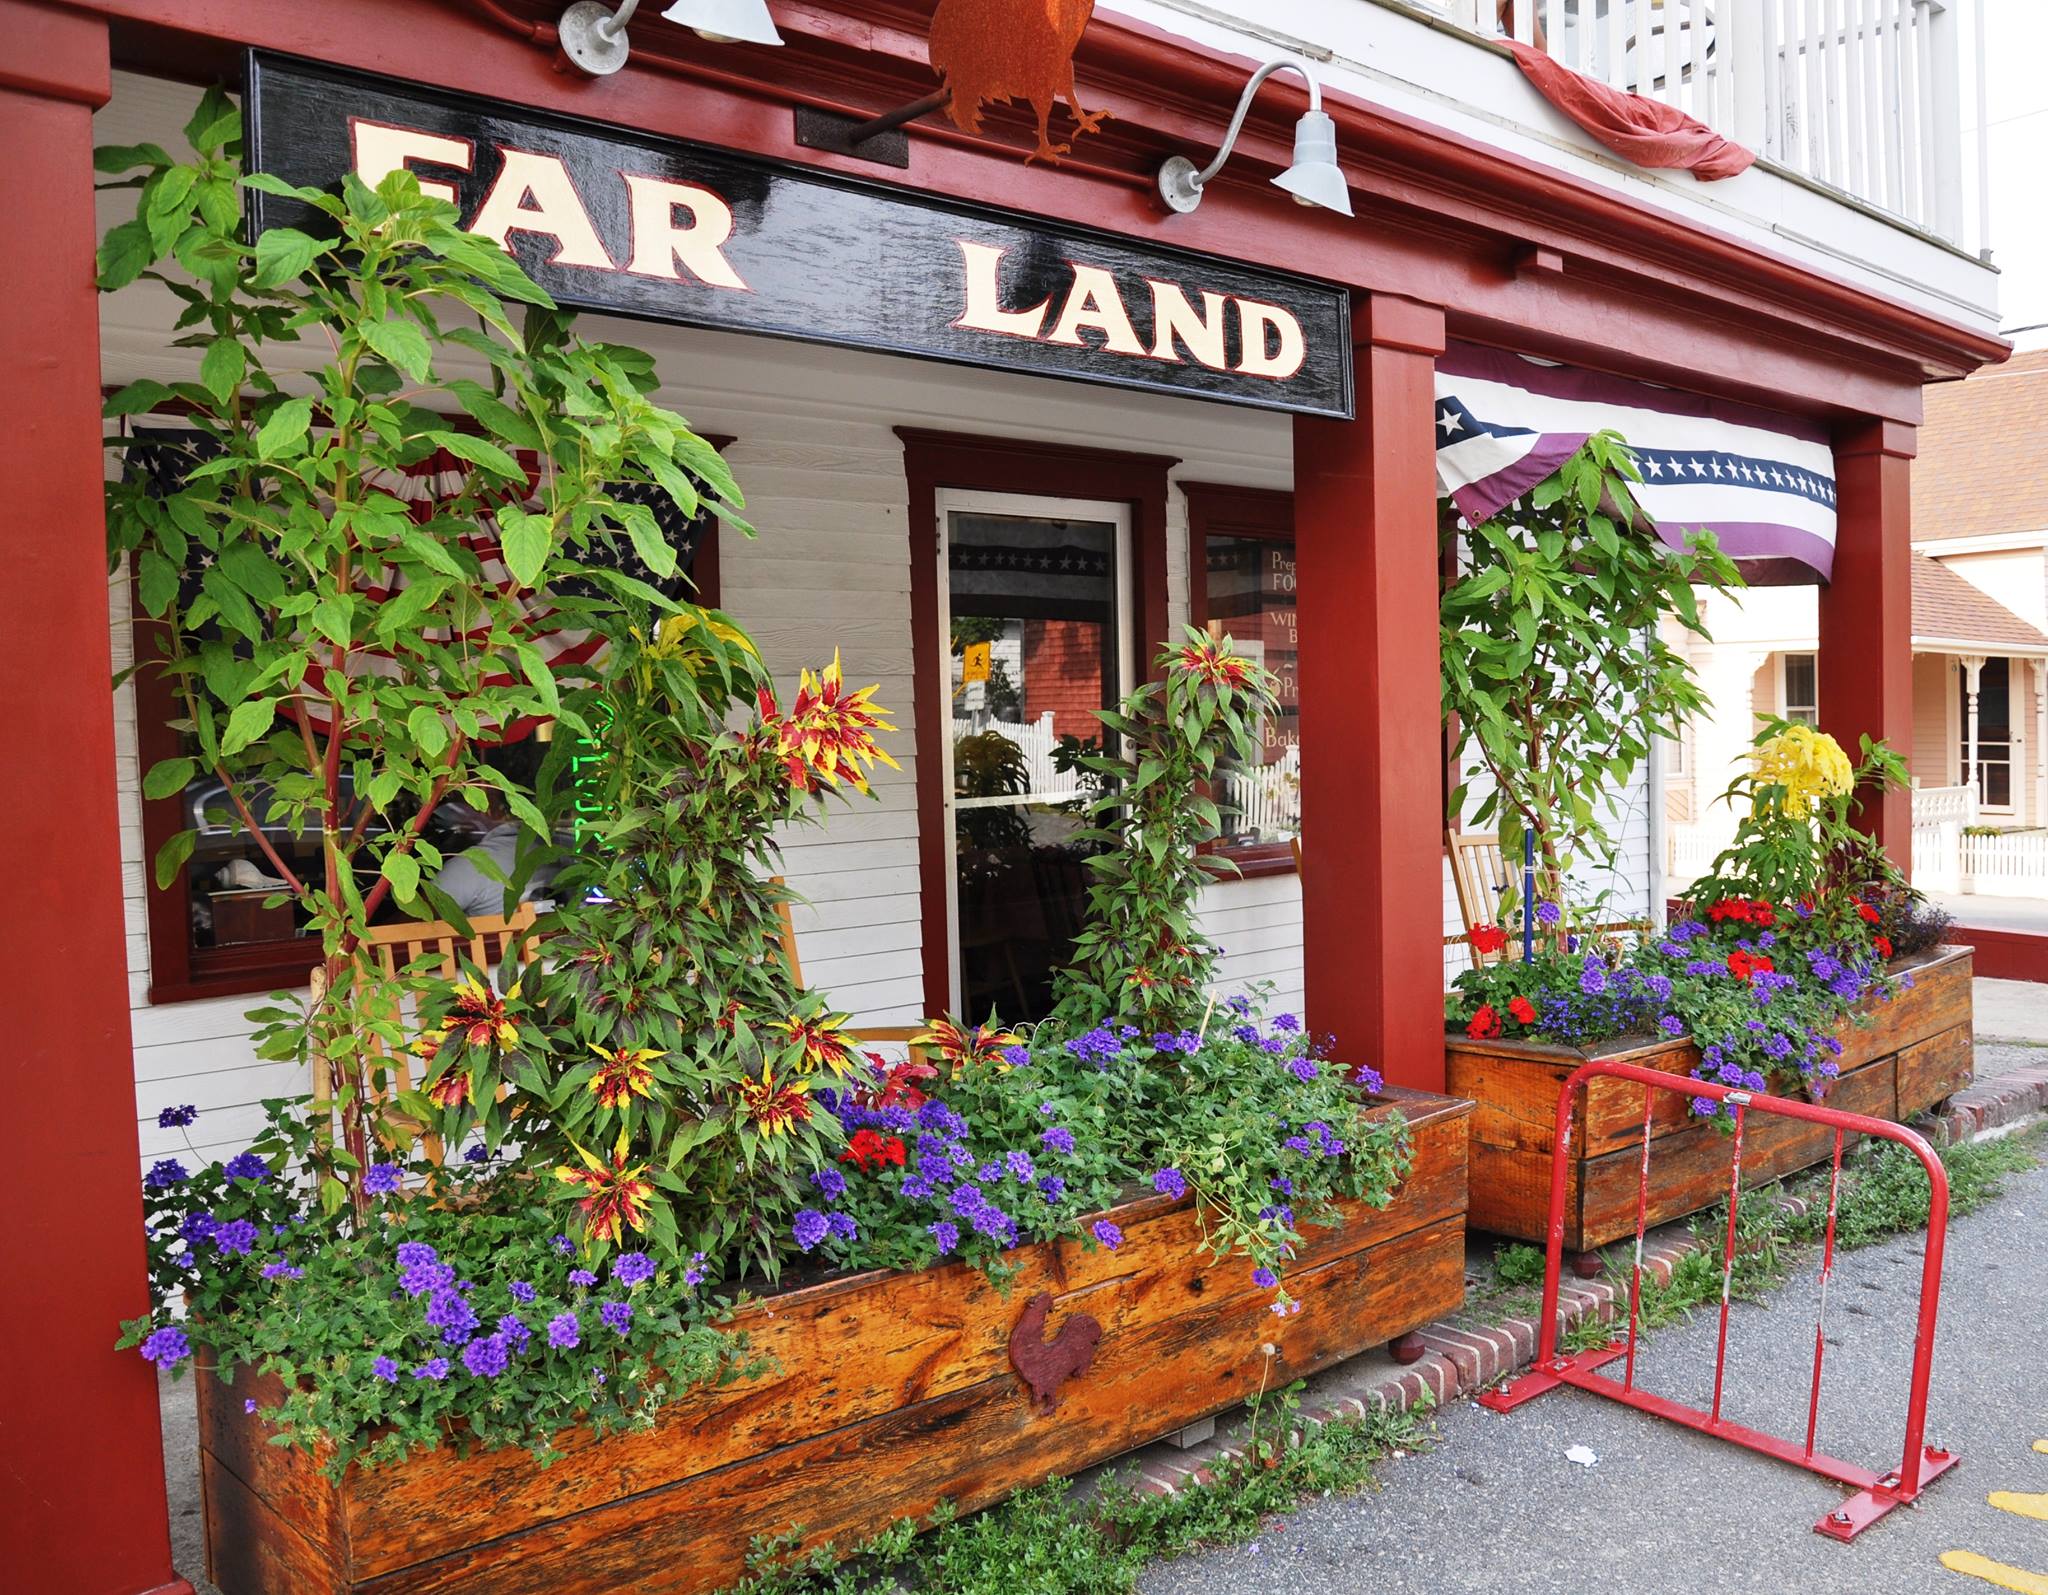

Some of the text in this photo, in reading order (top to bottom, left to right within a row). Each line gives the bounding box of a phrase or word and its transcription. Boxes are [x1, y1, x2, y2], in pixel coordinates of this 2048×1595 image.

[947, 238, 1307, 381] LAND
[1273, 573, 1297, 592] FO
[1265, 727, 1299, 748] Bak
